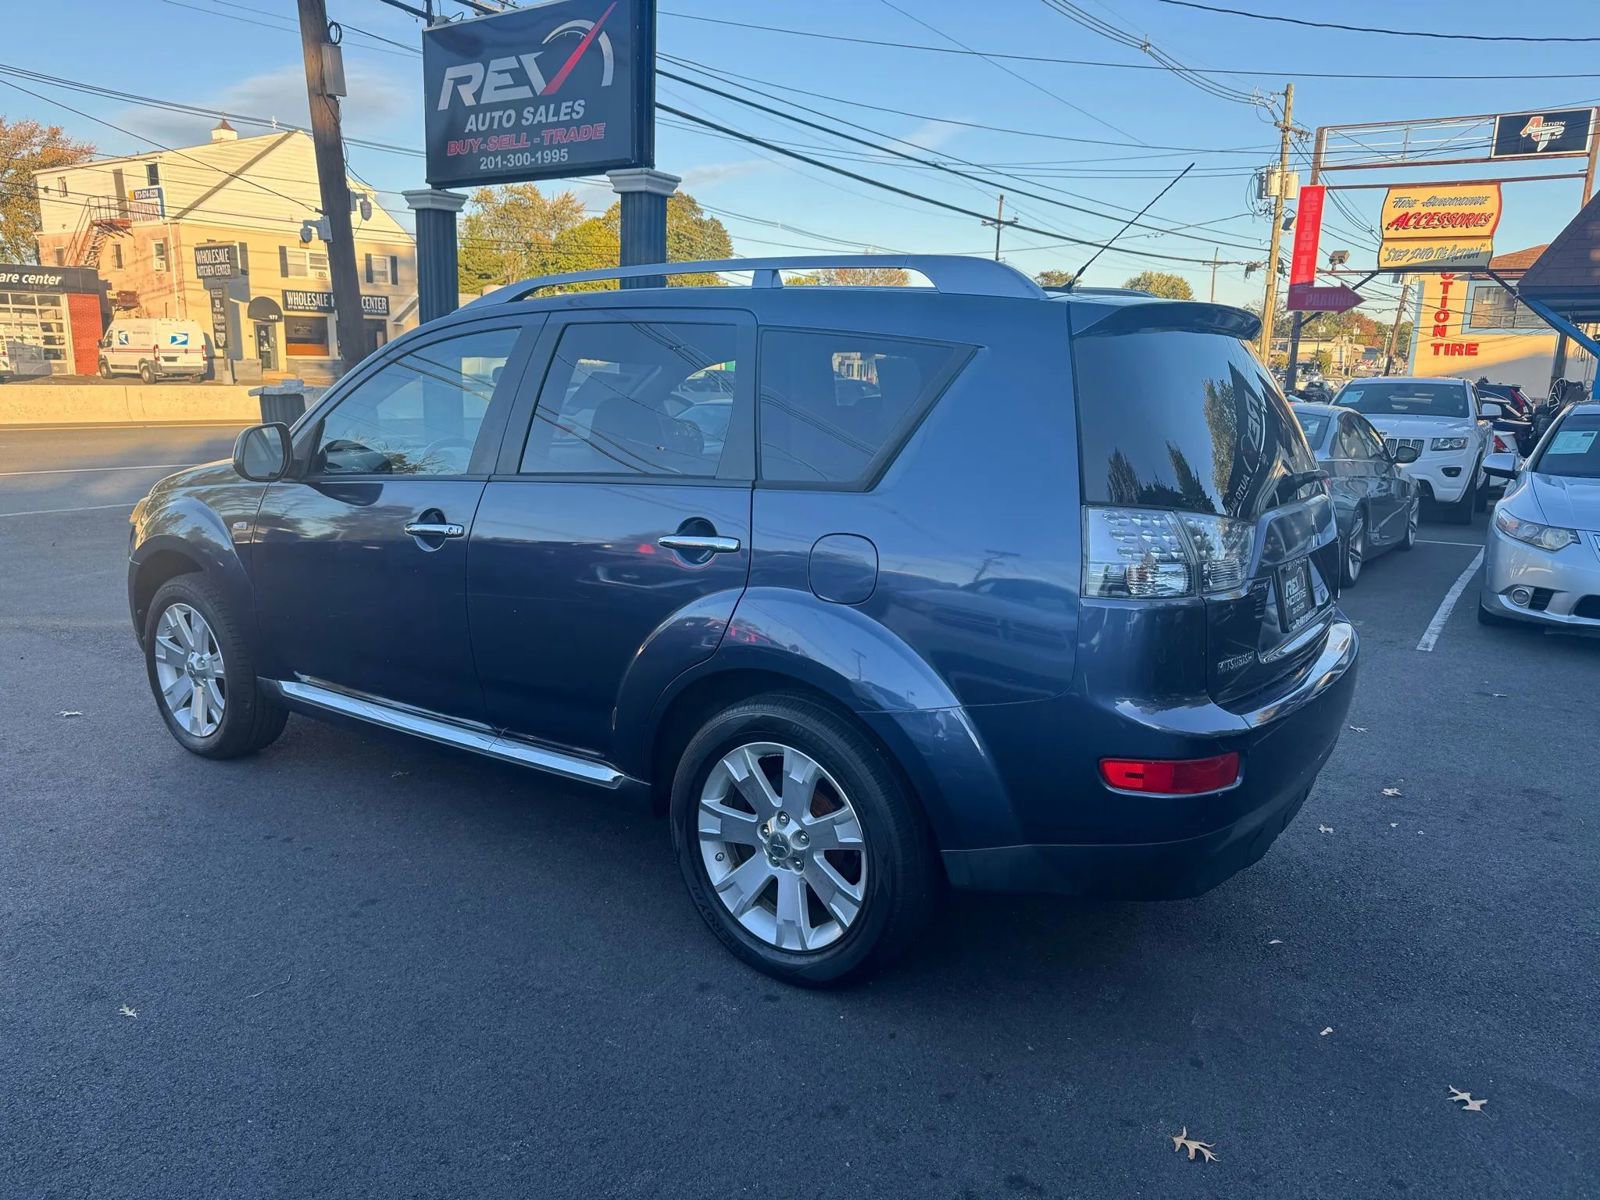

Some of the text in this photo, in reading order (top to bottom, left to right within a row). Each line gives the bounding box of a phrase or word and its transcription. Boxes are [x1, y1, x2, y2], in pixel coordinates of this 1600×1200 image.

[464, 99, 586, 133] AUTO SALES
[479, 148, 569, 170] 201-300-1995
[1386, 211, 1494, 231] ACCESSORIES
[195, 248, 230, 264] WHOLESALE
[22, 273, 62, 285] center
[286, 291, 329, 307] WHOLESALE
[361, 296, 387, 310] CENTER
[1430, 343, 1479, 356] TIRE
